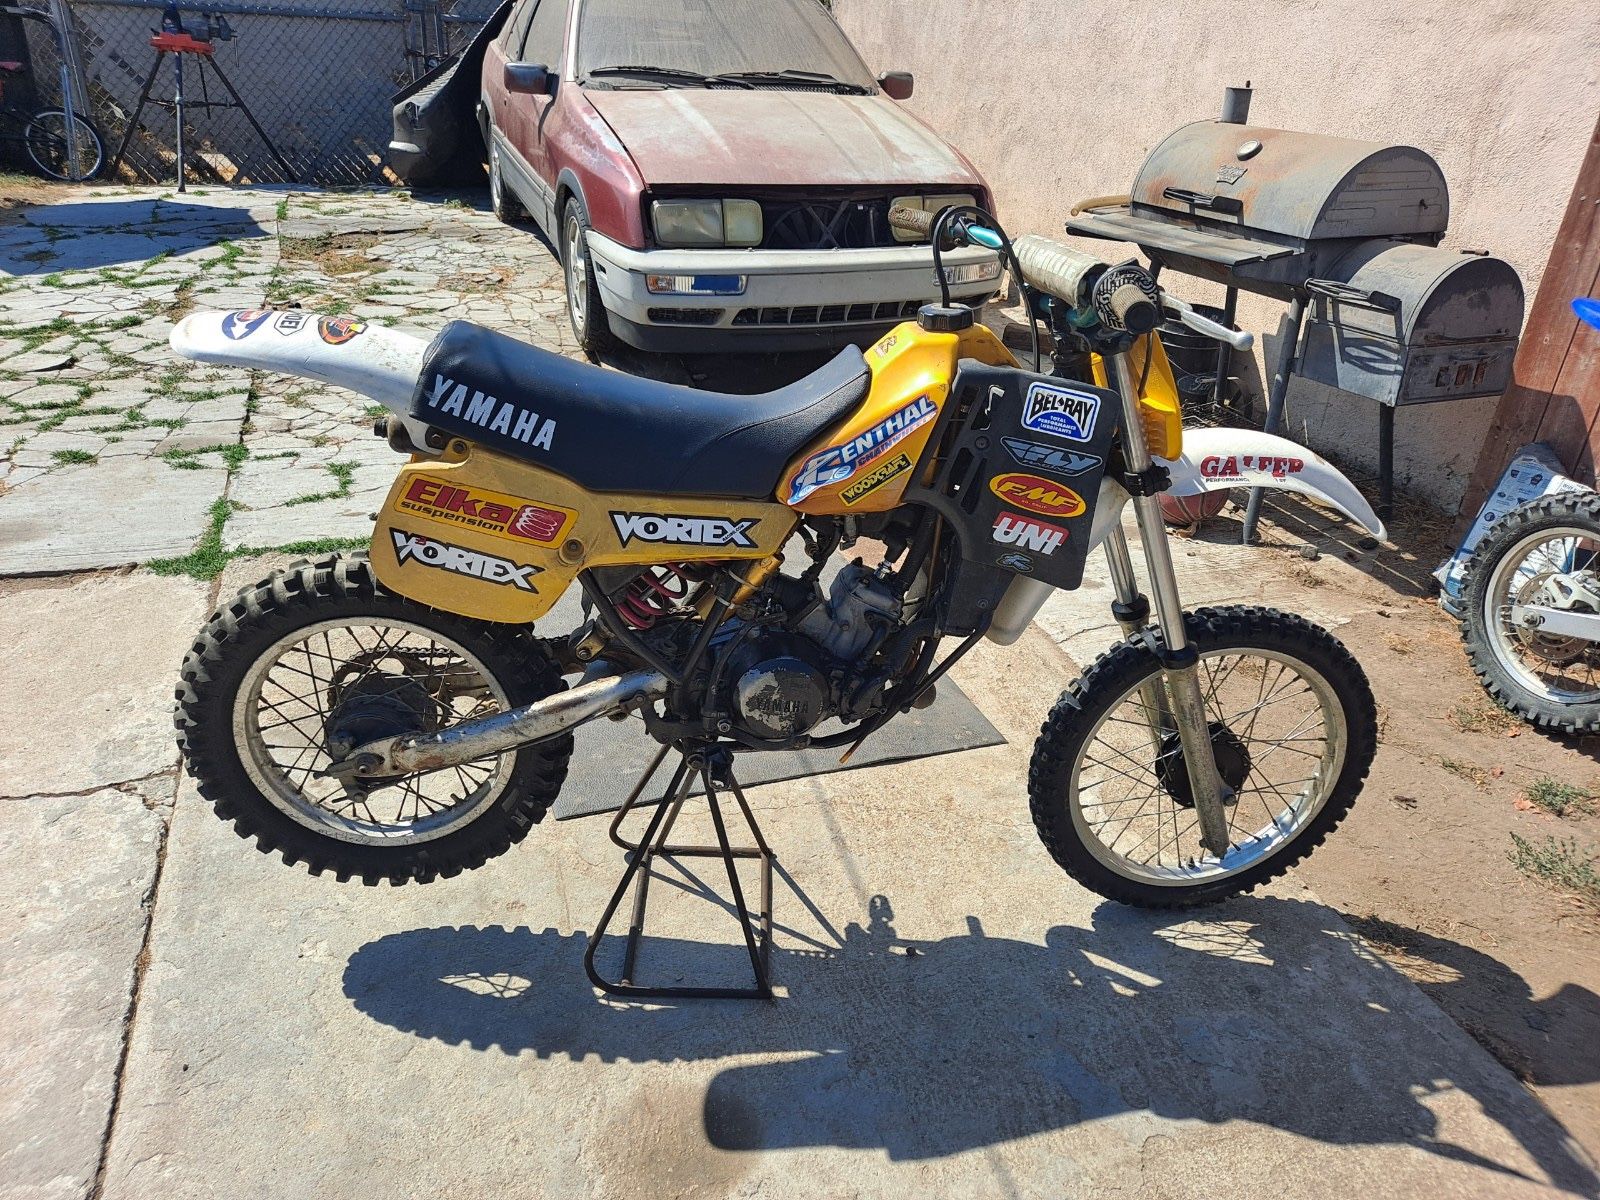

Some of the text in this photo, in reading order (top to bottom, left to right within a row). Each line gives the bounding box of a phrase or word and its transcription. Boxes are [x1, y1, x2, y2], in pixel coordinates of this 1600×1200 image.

[427, 374, 557, 451] YAMAHA
[1038, 418, 1077, 431] PERFORMANCE
[1040, 423, 1072, 434] LUBRICANTS
[796, 397, 935, 488] RENTHAL
[1020, 444, 1099, 471] FLY
[844, 456, 907, 498] WOODCRAFT
[996, 481, 1081, 507] FMF
[400, 501, 506, 533] suspension
[405, 478, 514, 525] Elka
[612, 514, 754, 547] VORTEX
[993, 517, 1063, 554] UNI
[393, 531, 537, 590] VORTEX
